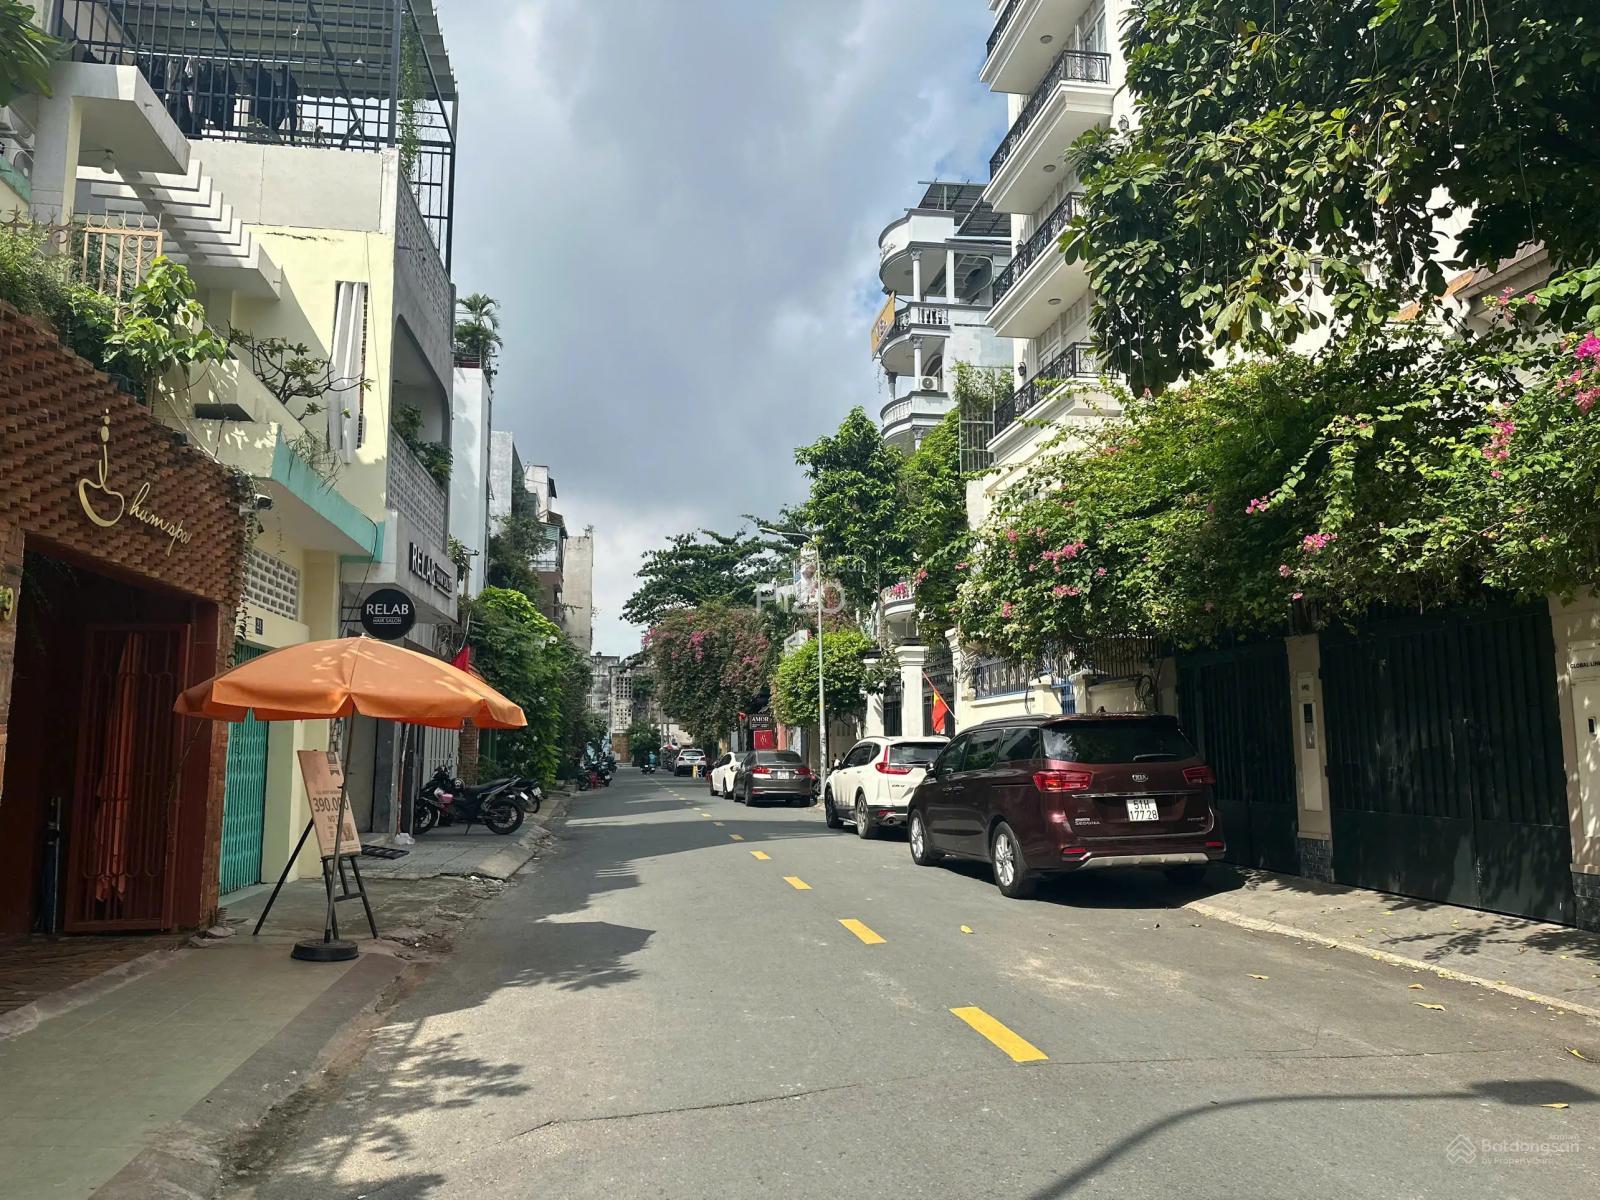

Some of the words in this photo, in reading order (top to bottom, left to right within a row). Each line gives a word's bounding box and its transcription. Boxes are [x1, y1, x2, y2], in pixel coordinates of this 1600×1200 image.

[410, 542, 436, 586] RELAB
[366, 603, 409, 615] RELAB
[1133, 799, 1150, 810] 51H
